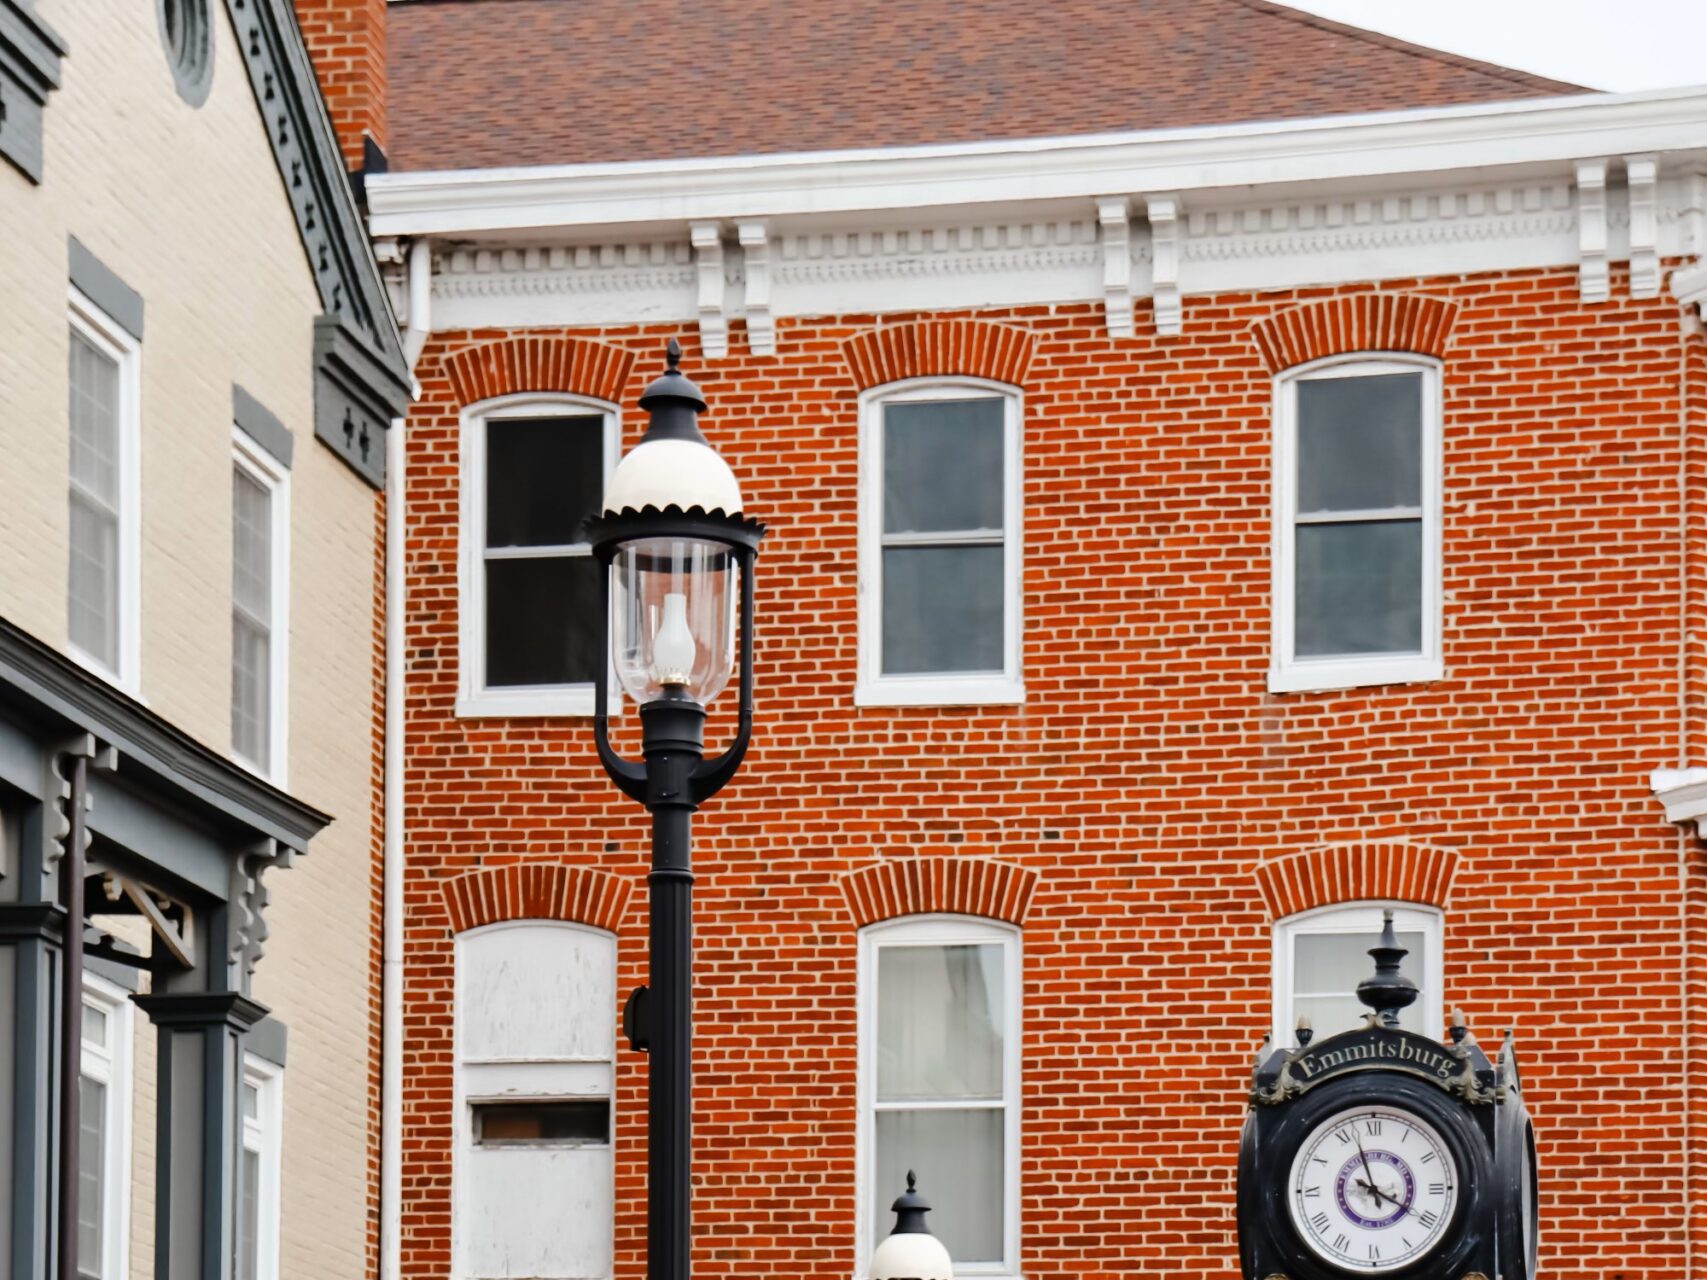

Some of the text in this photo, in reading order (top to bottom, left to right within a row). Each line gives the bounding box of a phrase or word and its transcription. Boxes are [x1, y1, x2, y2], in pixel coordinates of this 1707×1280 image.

[1298, 1036, 1456, 1078] Emmitsburg
[1366, 1121, 1382, 1136] XII
[1335, 1129, 1351, 1147] XI
[1401, 1129, 1409, 1143] I
[1312, 1154, 1328, 1168] X
[1420, 1151, 1436, 1164] II
[1304, 1185, 1320, 1197] IX
[1429, 1183, 1444, 1195] III
[1311, 1211, 1331, 1235] VIII
[1333, 1233, 1350, 1253] VII
[1368, 1245, 1380, 1259] VI
